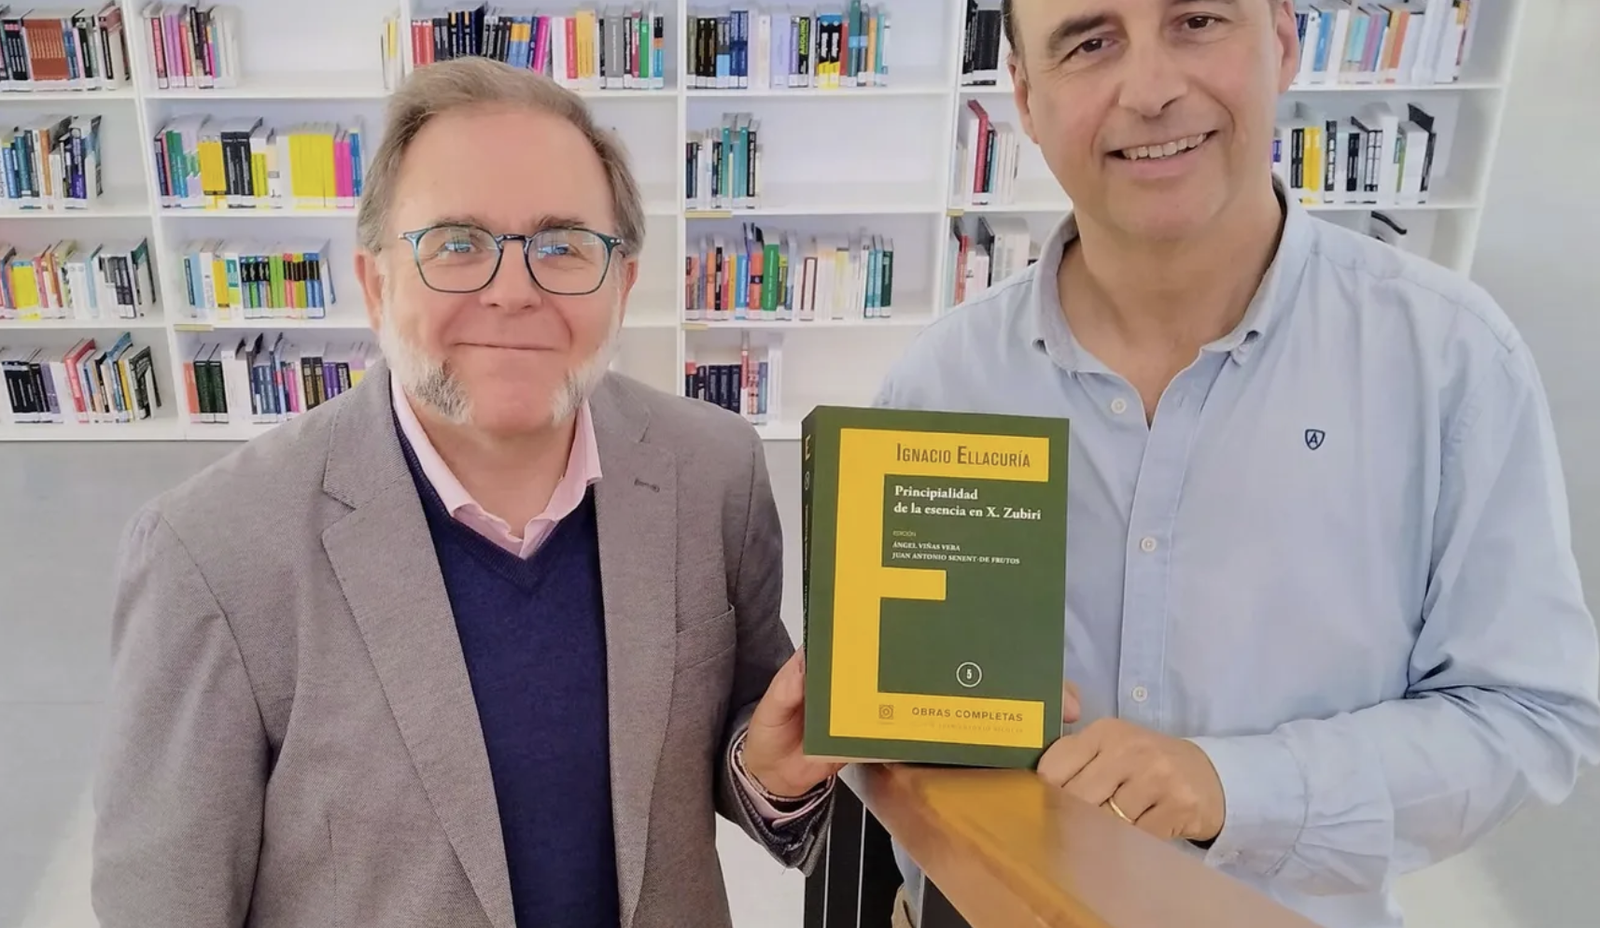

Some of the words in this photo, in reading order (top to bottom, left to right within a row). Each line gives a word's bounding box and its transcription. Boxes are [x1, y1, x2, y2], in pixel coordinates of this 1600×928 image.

[896, 443, 951, 464] IGNACIO
[957, 445, 1031, 468] ELLACURÍA
[895, 485, 978, 501] Principialidad
[894, 502, 908, 513] de
[911, 502, 922, 514] la
[924, 505, 966, 516] esencia
[969, 508, 983, 517] en
[986, 506, 1000, 518] X.
[1003, 507, 1041, 520] Zubiri
[892, 541, 918, 549] ÁNGEL
[918, 542, 941, 550] VIÑAS
[892, 552, 911, 560] JUAN
[991, 557, 1020, 565] FRUTOS
[966, 668, 973, 680] 5
[911, 707, 951, 717] OBRAS
[955, 709, 1024, 722] COMPLETAS
